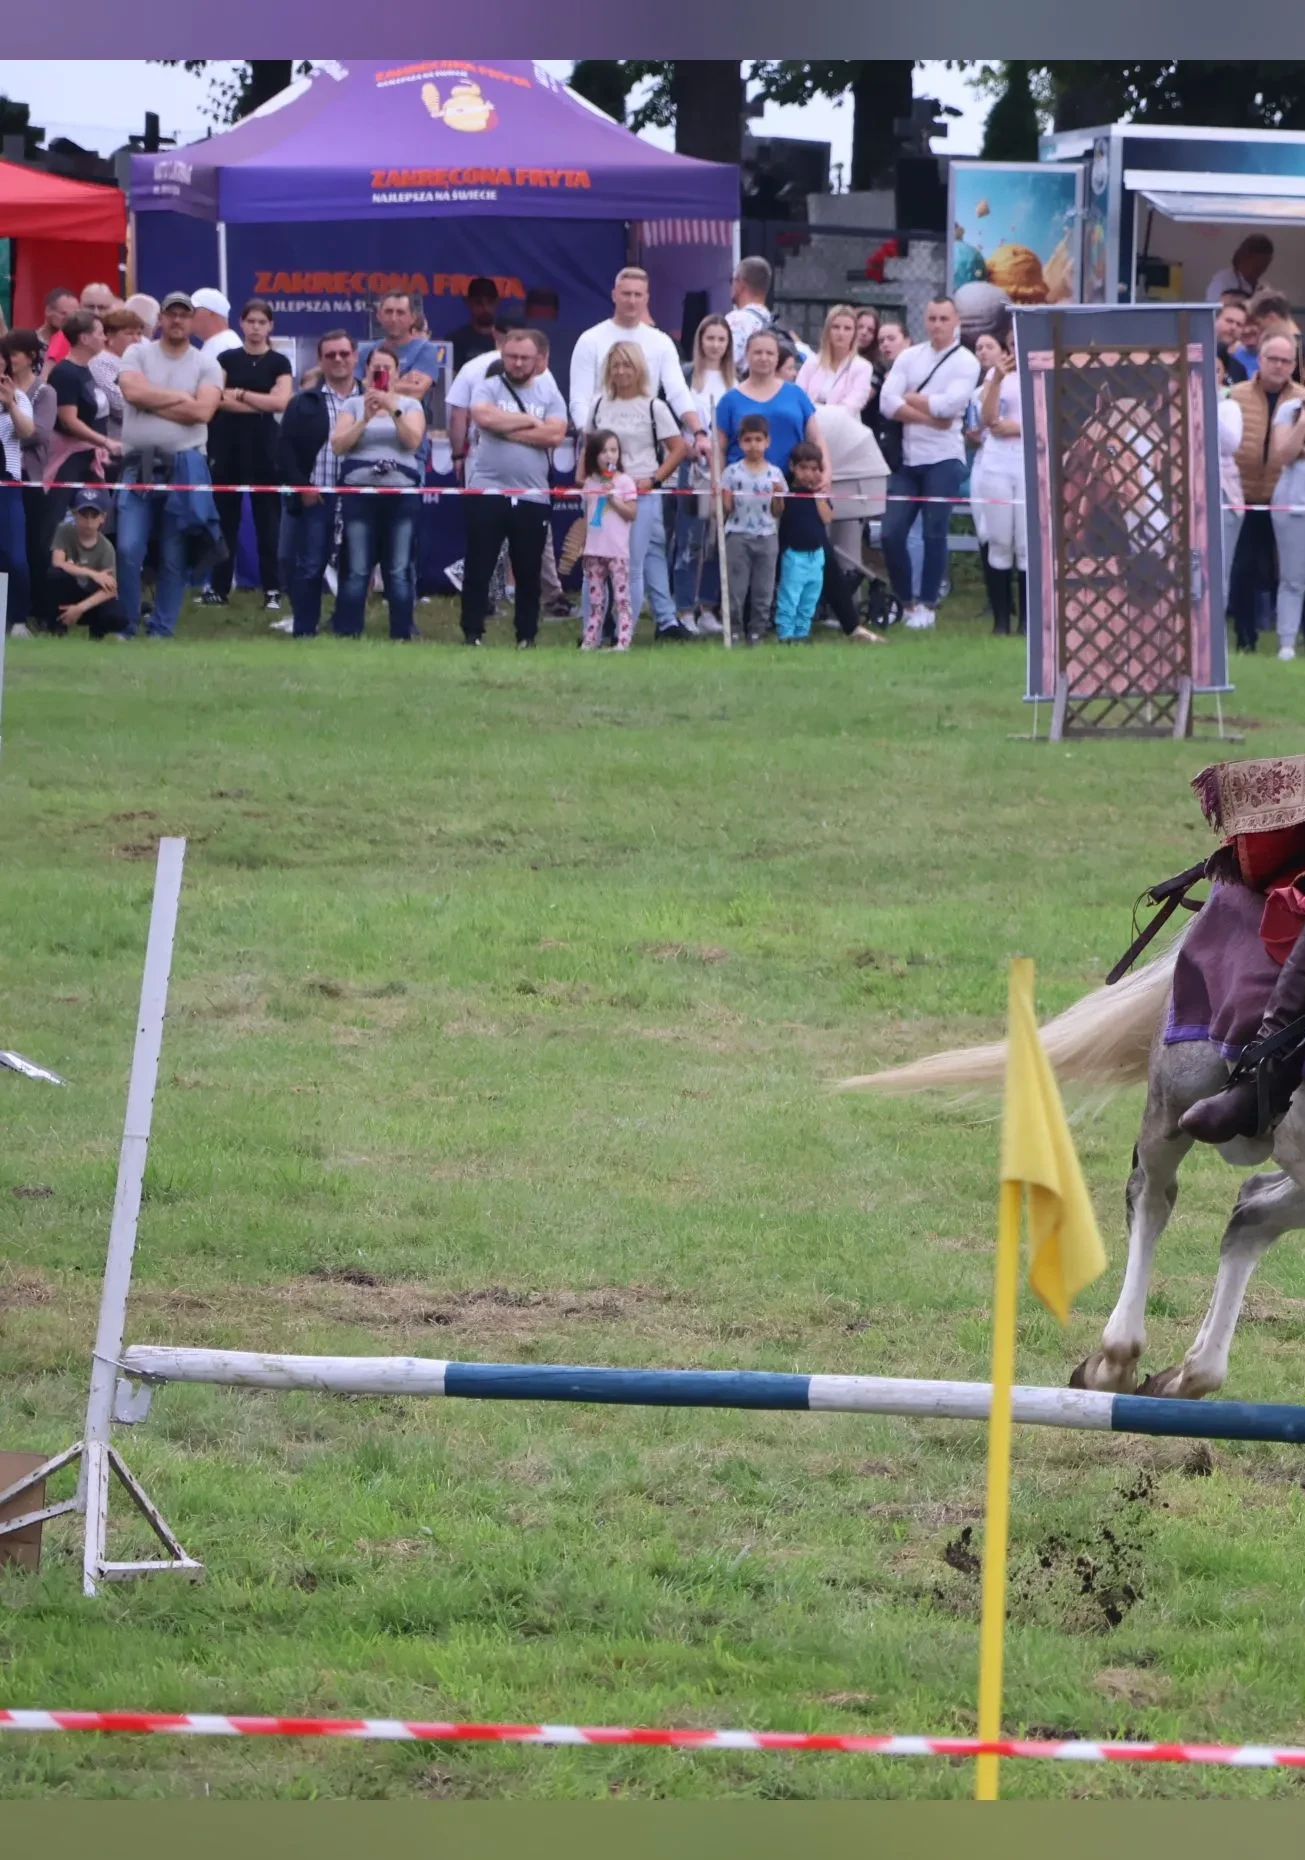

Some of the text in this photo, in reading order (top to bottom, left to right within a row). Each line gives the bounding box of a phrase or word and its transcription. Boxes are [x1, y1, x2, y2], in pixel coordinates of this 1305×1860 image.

[515, 168, 591, 188] FRYTA
[372, 191, 433, 203] NAJLEPSZA
[434, 190, 450, 201] NA
[254, 271, 526, 299] ZAKRĘCONA FRTA
[267, 300, 331, 312] AJLEPSZA
[333, 300, 353, 312] NA
